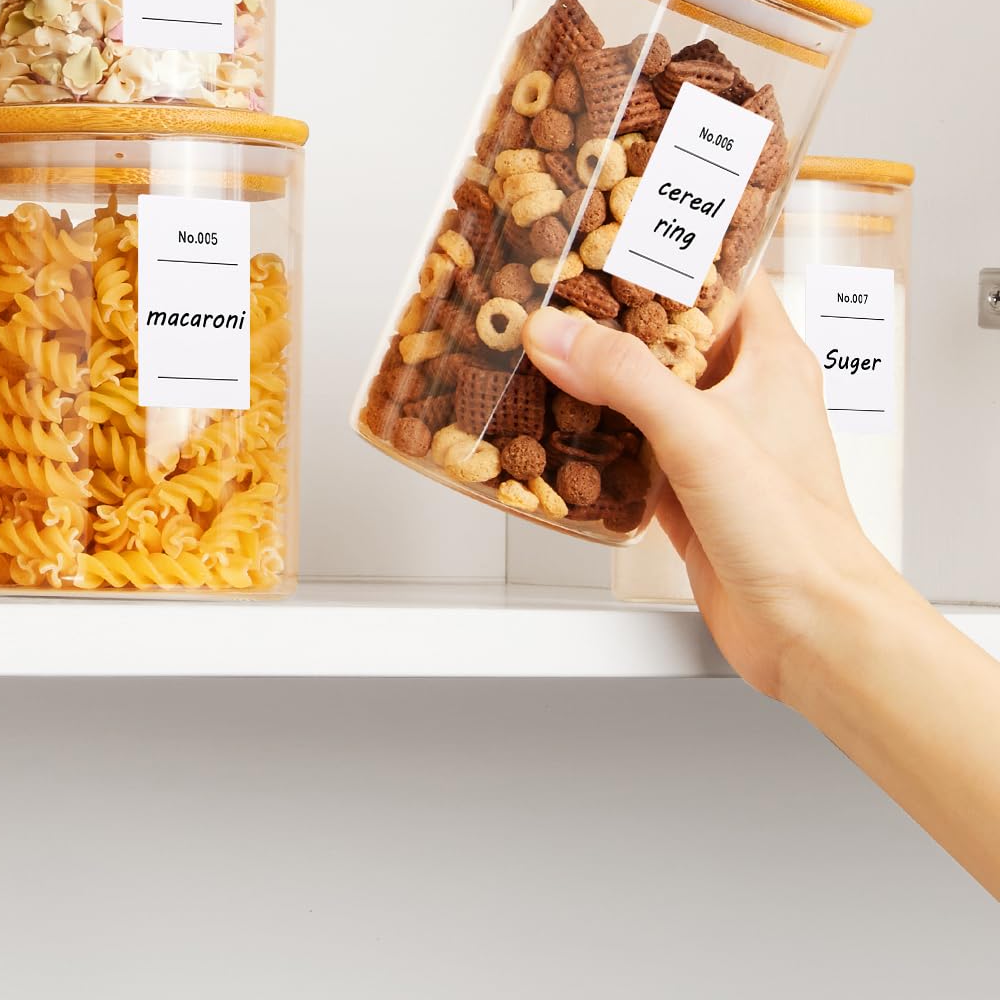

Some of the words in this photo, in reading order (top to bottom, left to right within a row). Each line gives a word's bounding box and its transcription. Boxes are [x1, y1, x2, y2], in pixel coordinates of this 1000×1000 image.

[698, 126, 735, 152] No.006
[657, 181, 726, 219] cereal
[178, 230, 218, 246] No.005
[653, 218, 697, 251] ring
[837, 292, 869, 305] No.007
[146, 310, 247, 330] macaroni
[823, 348, 882, 375] Suger
